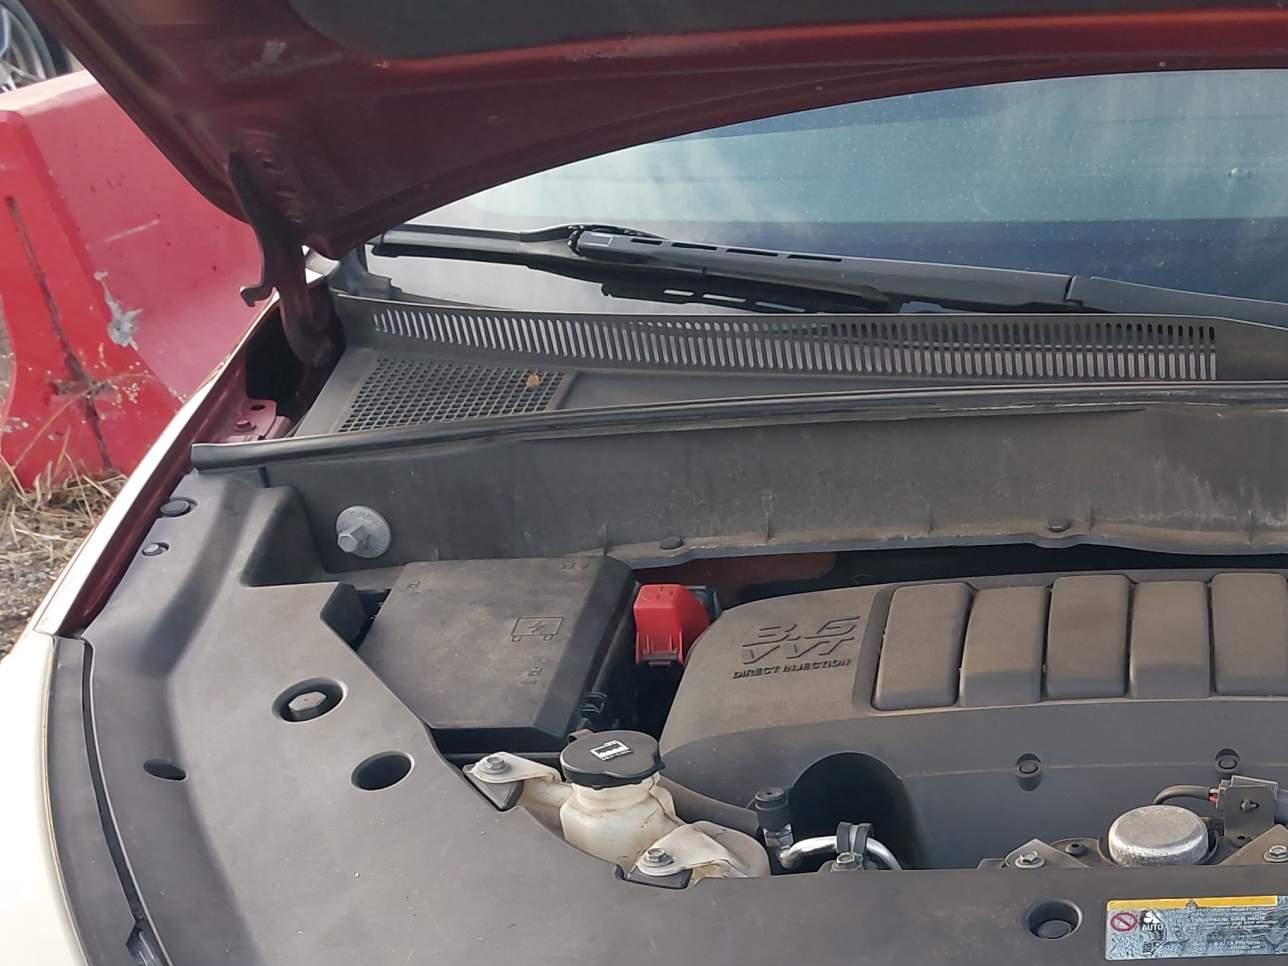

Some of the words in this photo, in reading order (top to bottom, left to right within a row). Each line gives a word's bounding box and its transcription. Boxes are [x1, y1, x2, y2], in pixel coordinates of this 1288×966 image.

[742, 616, 860, 647] 3.6
[741, 636, 856, 665] VVT
[733, 666, 781, 680] DIRECT
[782, 659, 852, 673] INJECTION
[1141, 924, 1164, 932] AUTO
